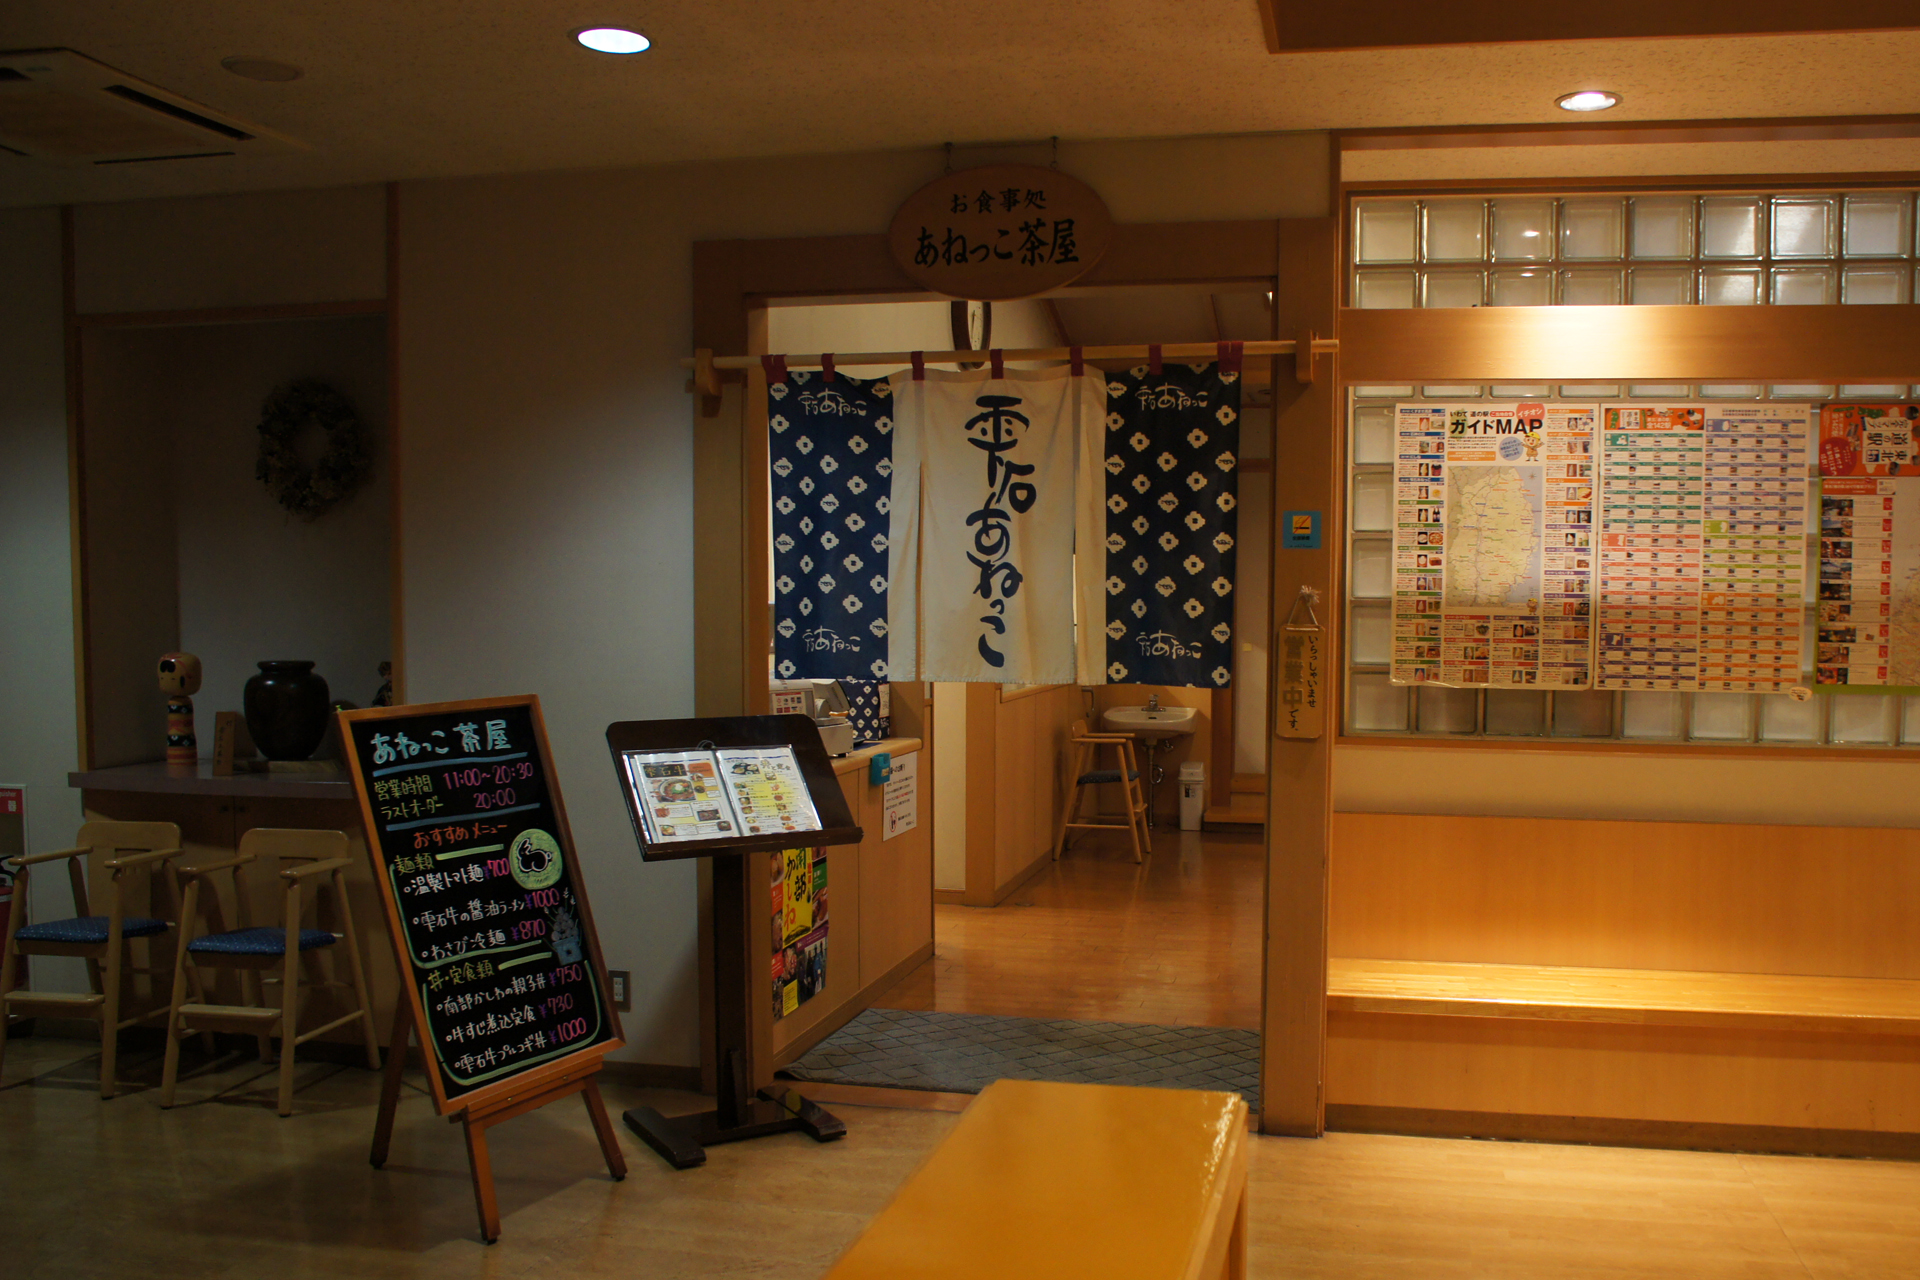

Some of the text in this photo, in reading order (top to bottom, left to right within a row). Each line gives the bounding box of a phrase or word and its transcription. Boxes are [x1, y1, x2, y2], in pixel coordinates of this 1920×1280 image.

[950, 187, 1047, 214] お食事処
[914, 217, 1080, 267] あねっこ茶屋
[1450, 418, 1543, 435] ガイドMAP
[1867, 432, 1909, 446] 道の駅
[964, 395, 1037, 668] 雫石あねっこ
[1307, 635, 1319, 708] いらっしゃいませ
[370, 719, 512, 765] あねっこ茶屋
[373, 774, 433, 802] 営業時間
[380, 787, 516, 820] ラストオーダー 20:00
[394, 852, 435, 876] 麺類
[483, 858, 510, 879] ¥700
[524, 887, 560, 910] ¥1000
[430, 918, 546, 961] わさび冷麺 ¥870
[548, 964, 583, 987] ¥750
[452, 993, 573, 1043] 牛すじ煮込定食 ¥730
[548, 1017, 587, 1045] ¥1000
